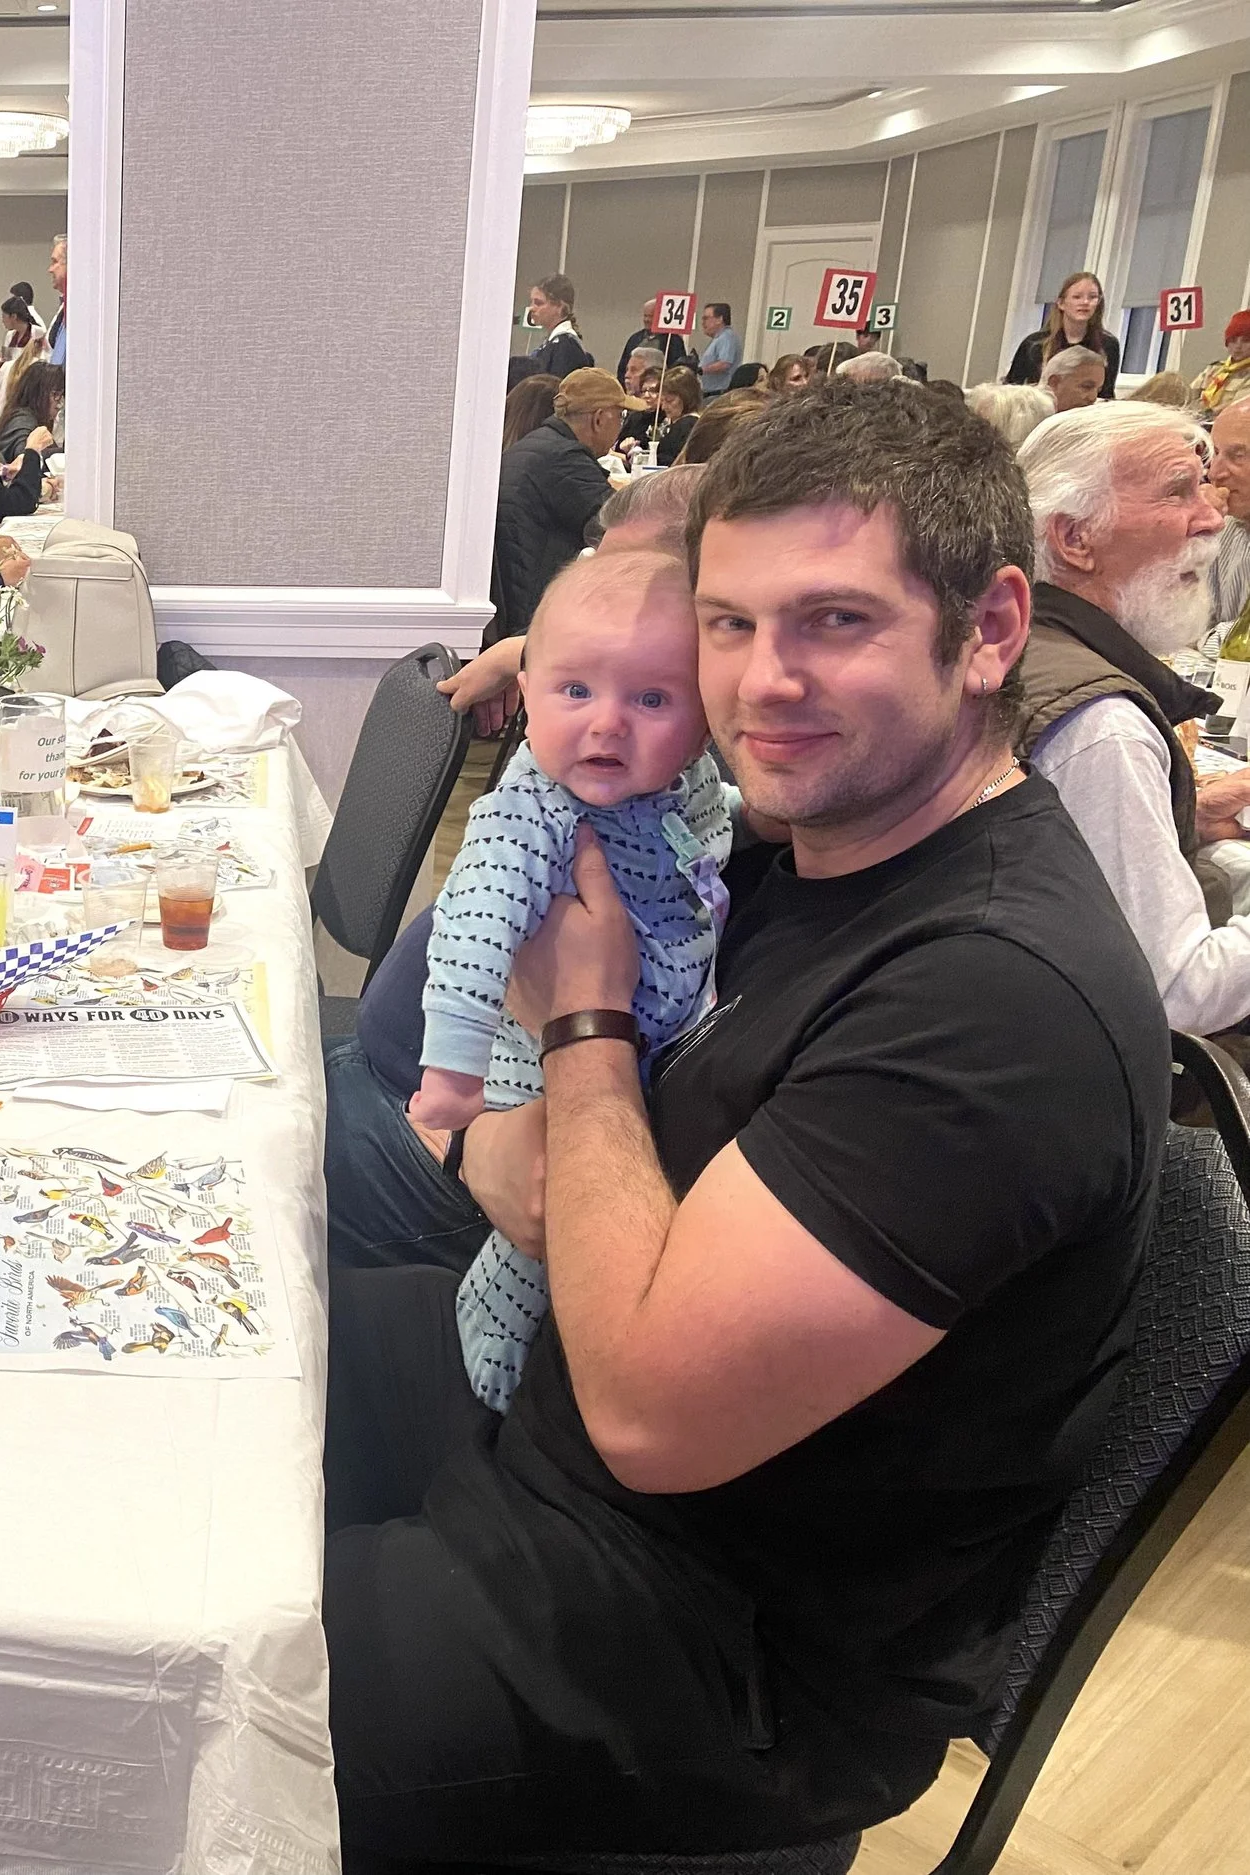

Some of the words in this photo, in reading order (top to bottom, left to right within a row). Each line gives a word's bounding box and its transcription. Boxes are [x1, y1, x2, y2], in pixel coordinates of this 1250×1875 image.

[831, 278, 864, 316] 35
[663, 298, 686, 325] 34
[877, 308, 891, 326] 3
[1170, 294, 1193, 322] 31
[772, 311, 786, 327] 2
[37, 737, 56, 747] Our
[18, 770, 36, 780] for
[37, 768, 59, 782] your
[24, 1011, 79, 1023] WAYS
[87, 1010, 126, 1022] FOR
[135, 1010, 164, 1021] 40
[173, 1009, 225, 1020] DAYS
[27, 1270, 35, 1301] AMERICA
[25, 1301, 34, 1325] NORTH
[24, 1326, 32, 1337] OF
